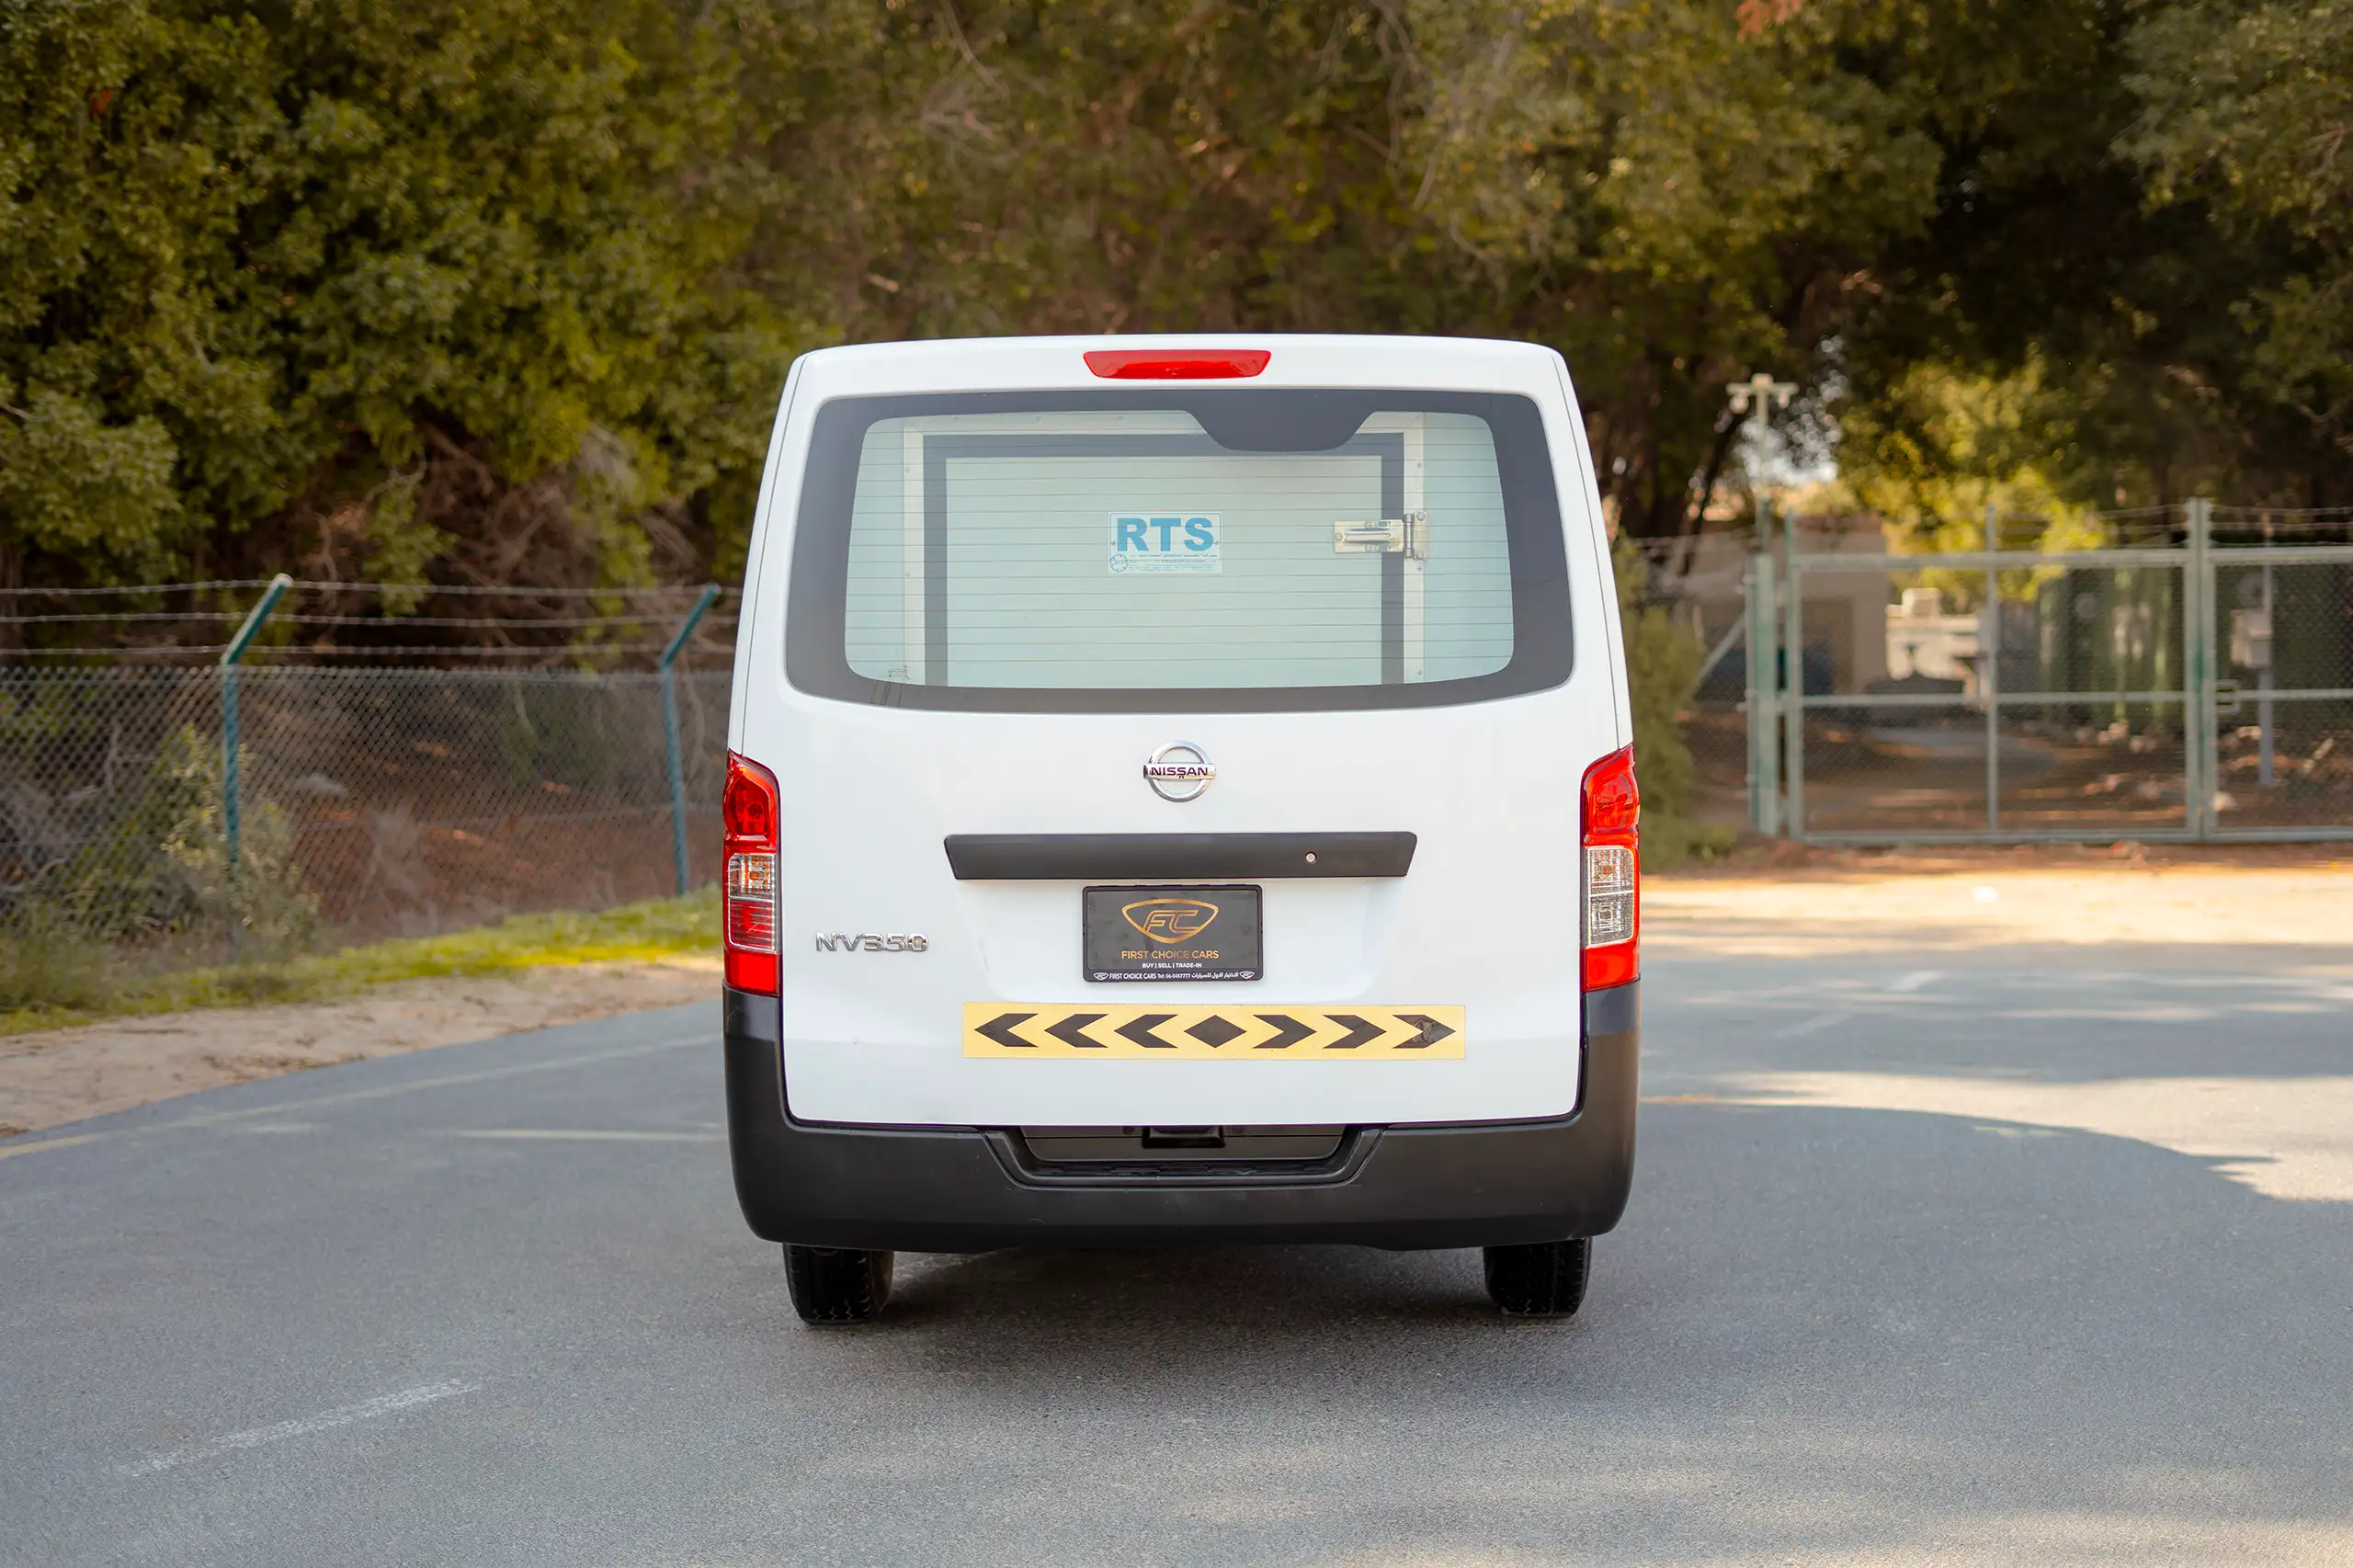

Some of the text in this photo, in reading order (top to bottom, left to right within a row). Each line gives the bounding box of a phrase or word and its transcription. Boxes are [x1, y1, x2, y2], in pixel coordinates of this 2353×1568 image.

[1117, 517, 1214, 551] RTS
[1151, 767, 1208, 776] NISSAN
[815, 932, 929, 952] NV350
[1121, 950, 1220, 960] FIRST CHOICE CARS
